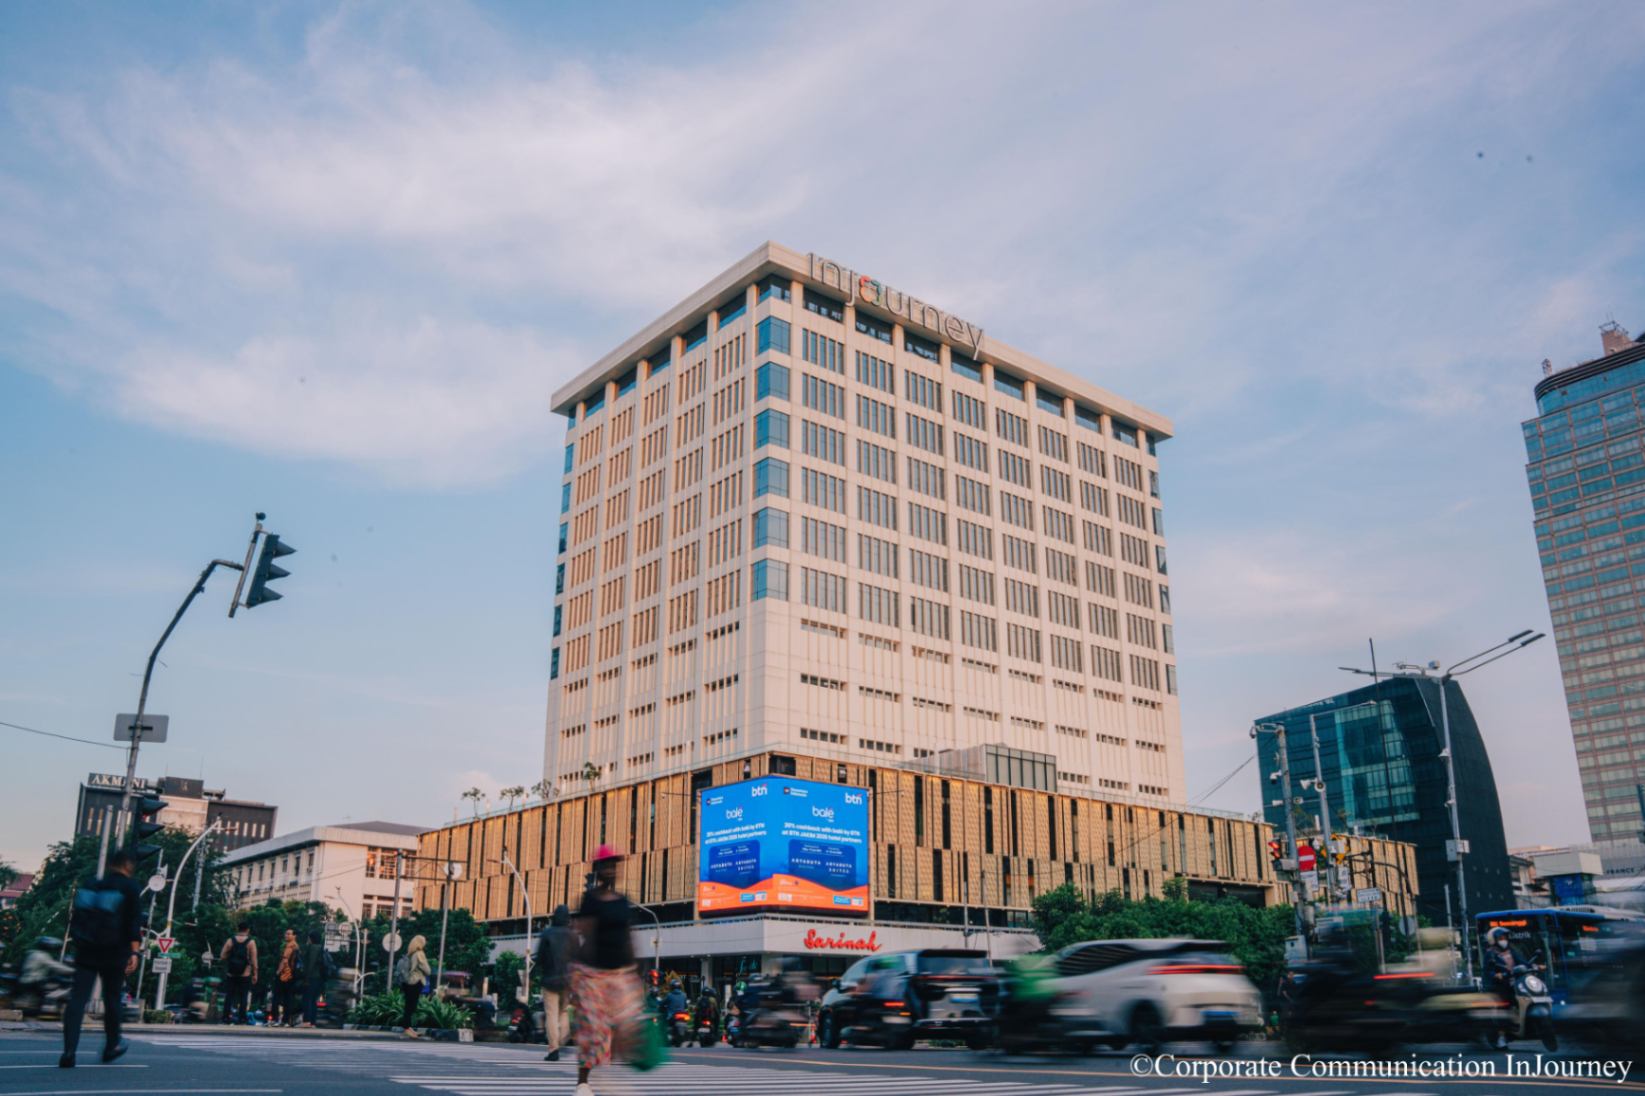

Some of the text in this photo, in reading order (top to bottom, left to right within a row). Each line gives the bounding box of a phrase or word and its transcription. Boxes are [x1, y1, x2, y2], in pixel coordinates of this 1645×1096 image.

[92, 774, 145, 788] AKMNI
[751, 784, 768, 797] btn
[845, 792, 862, 805] btn
[803, 928, 882, 951] Sarinah
